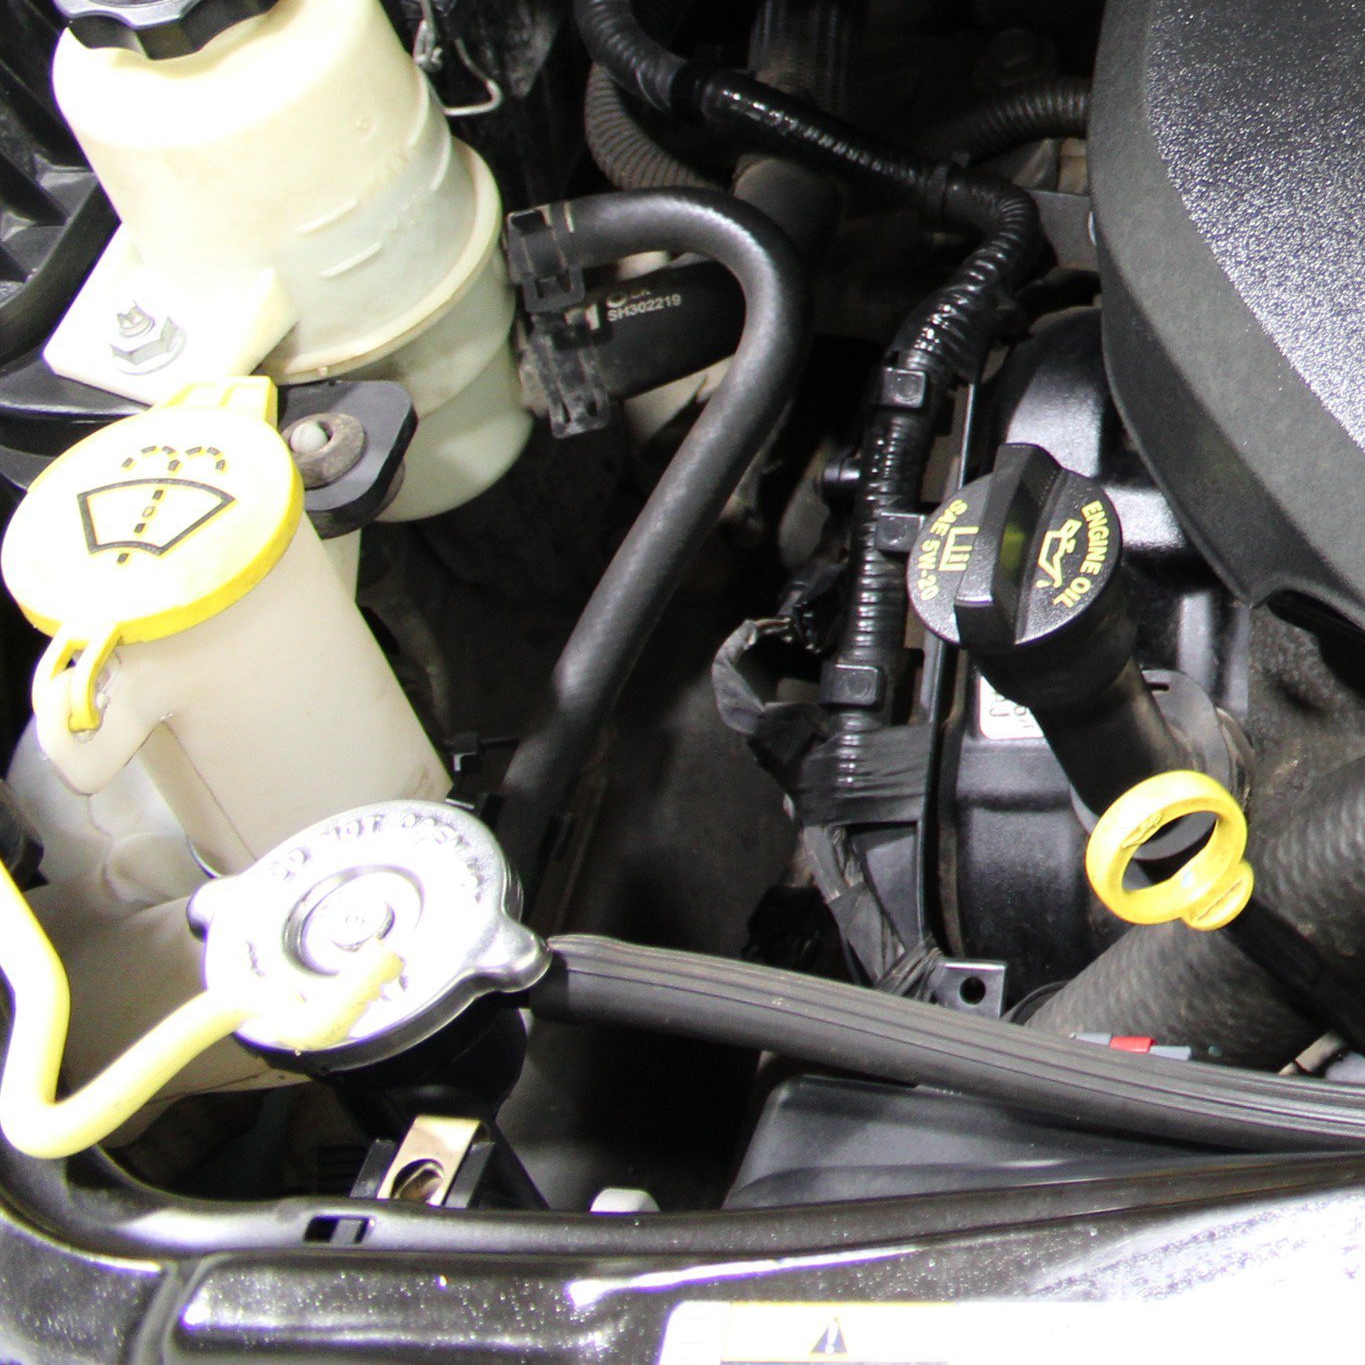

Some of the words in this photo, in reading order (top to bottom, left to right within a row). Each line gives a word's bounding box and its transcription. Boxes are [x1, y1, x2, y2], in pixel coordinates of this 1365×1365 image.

[930, 499, 968, 537] SAE
[1081, 500, 1110, 575] ENGINE
[916, 539, 941, 601] 5W-20
[1053, 577, 1091, 608] OIL
